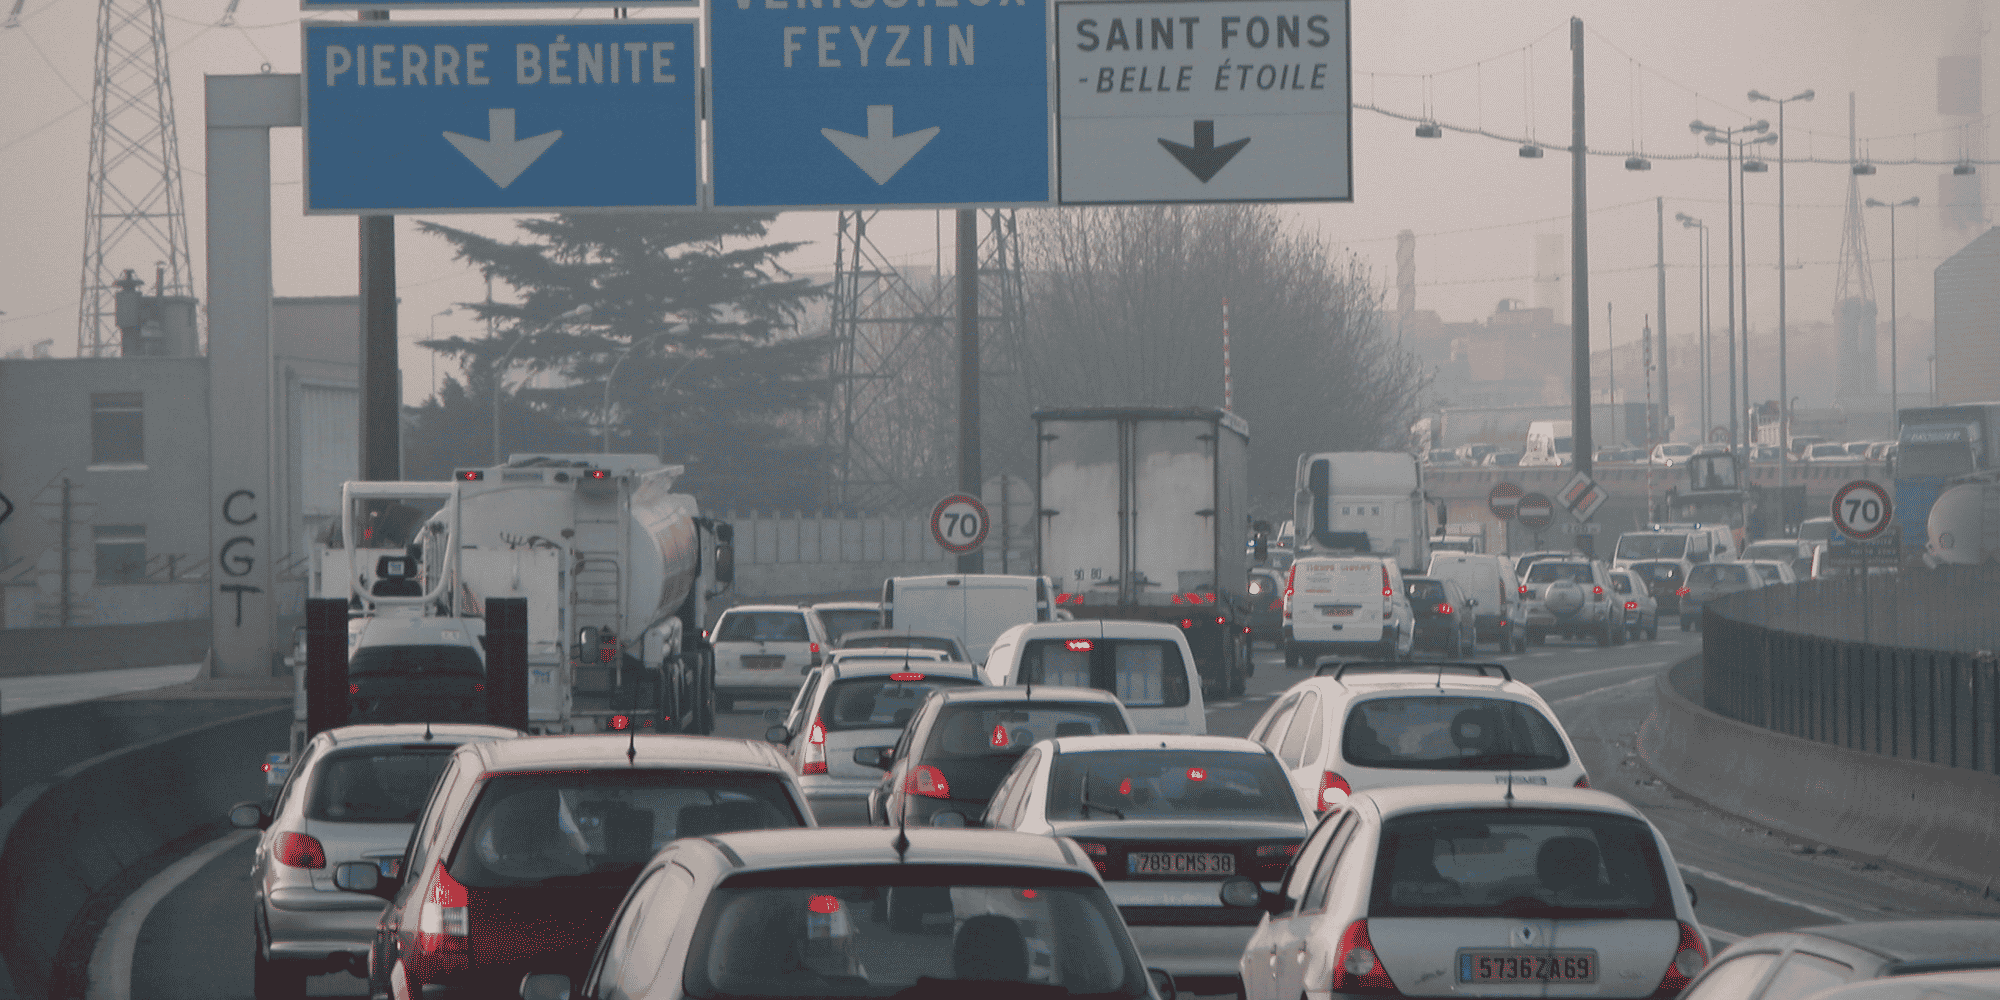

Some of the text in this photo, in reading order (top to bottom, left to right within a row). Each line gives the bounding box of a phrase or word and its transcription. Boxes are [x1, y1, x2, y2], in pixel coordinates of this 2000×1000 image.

[783, 24, 975, 68] FEYZIN
[1076, 14, 1331, 51] SAINT FONS
[326, 34, 676, 87] PIERRE BÉNITE
[1214, 58, 1328, 91] ÉTOILE
[944, 513, 978, 538] 70
[1846, 498, 1880, 523] 70
[220, 489, 264, 628] CGT
[1141, 853, 1231, 871] 789 CMS 38
